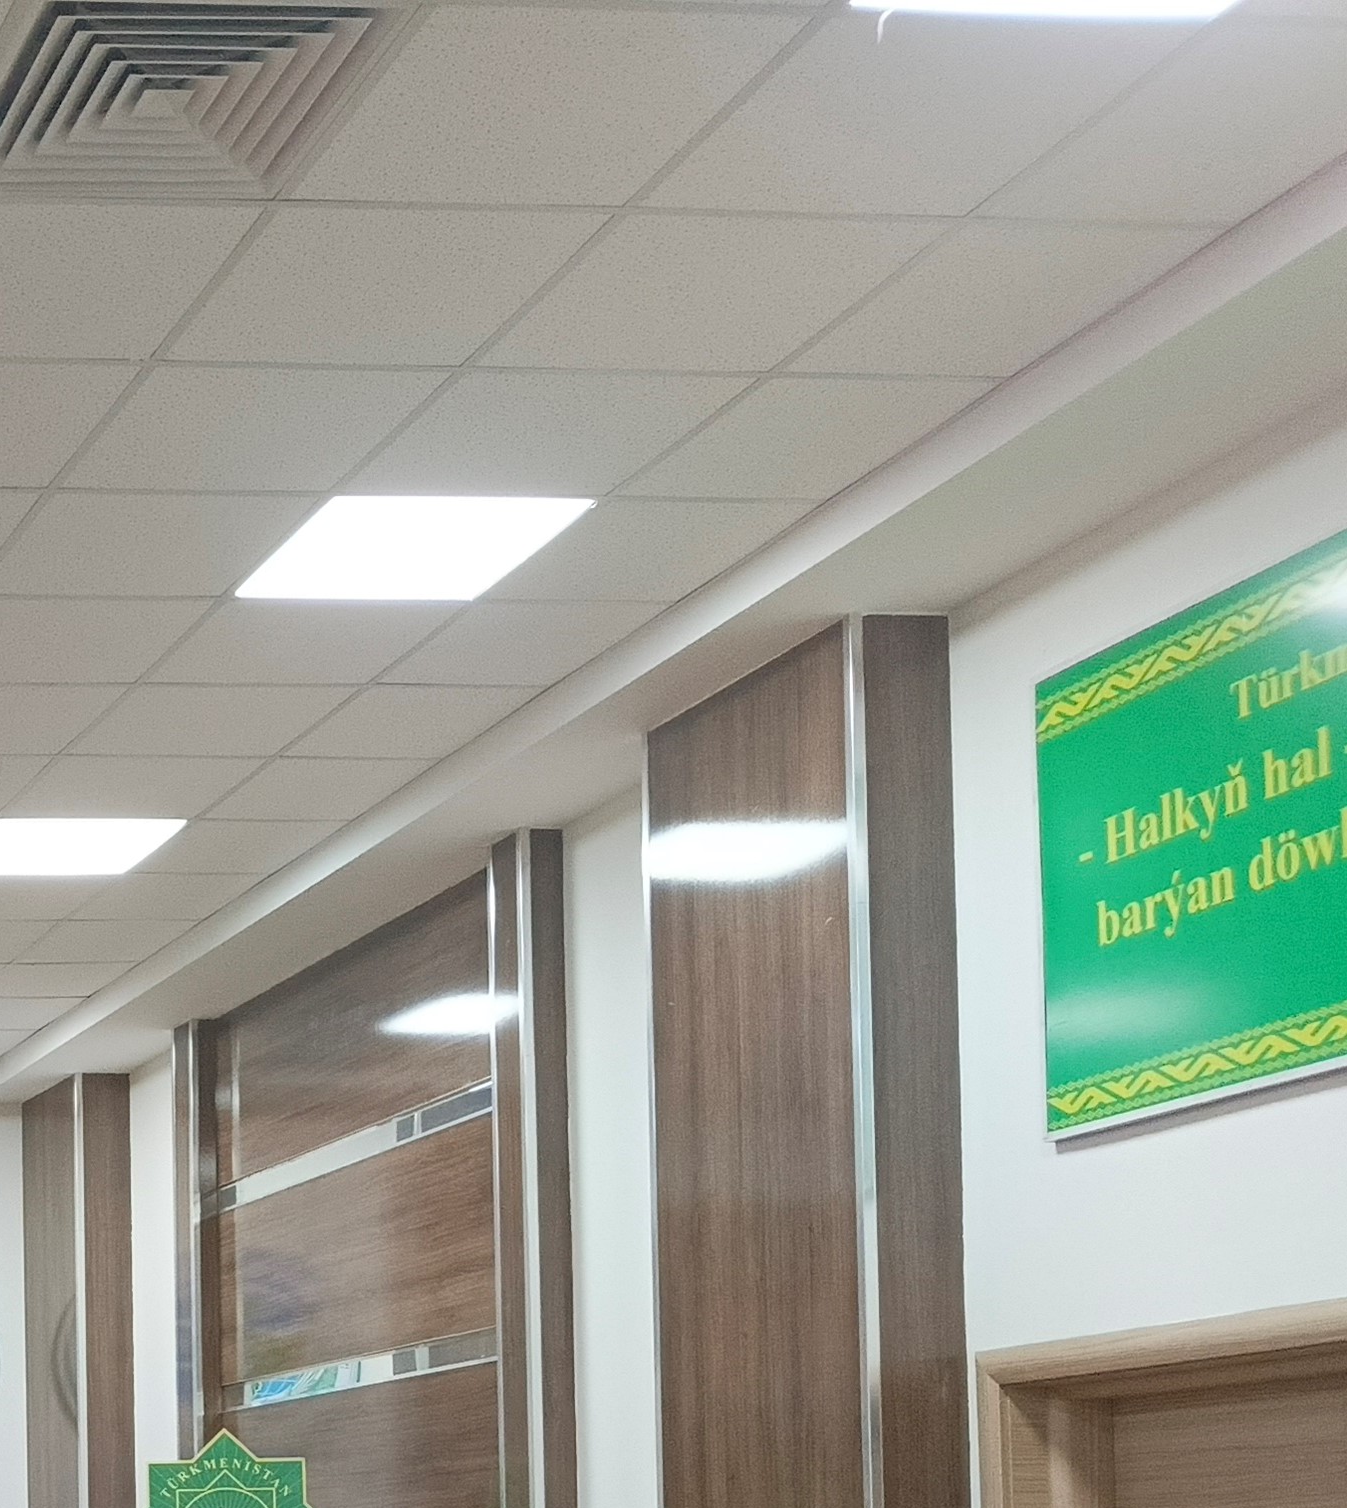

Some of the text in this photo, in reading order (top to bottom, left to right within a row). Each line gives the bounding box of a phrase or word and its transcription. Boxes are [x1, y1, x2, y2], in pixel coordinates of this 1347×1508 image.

[1103, 758, 1248, 864] Halkyň
[1262, 725, 1333, 800] hal
[1096, 867, 1236, 947] barýan
[159, 1457, 291, 1498] TÜRKMENISTAN
